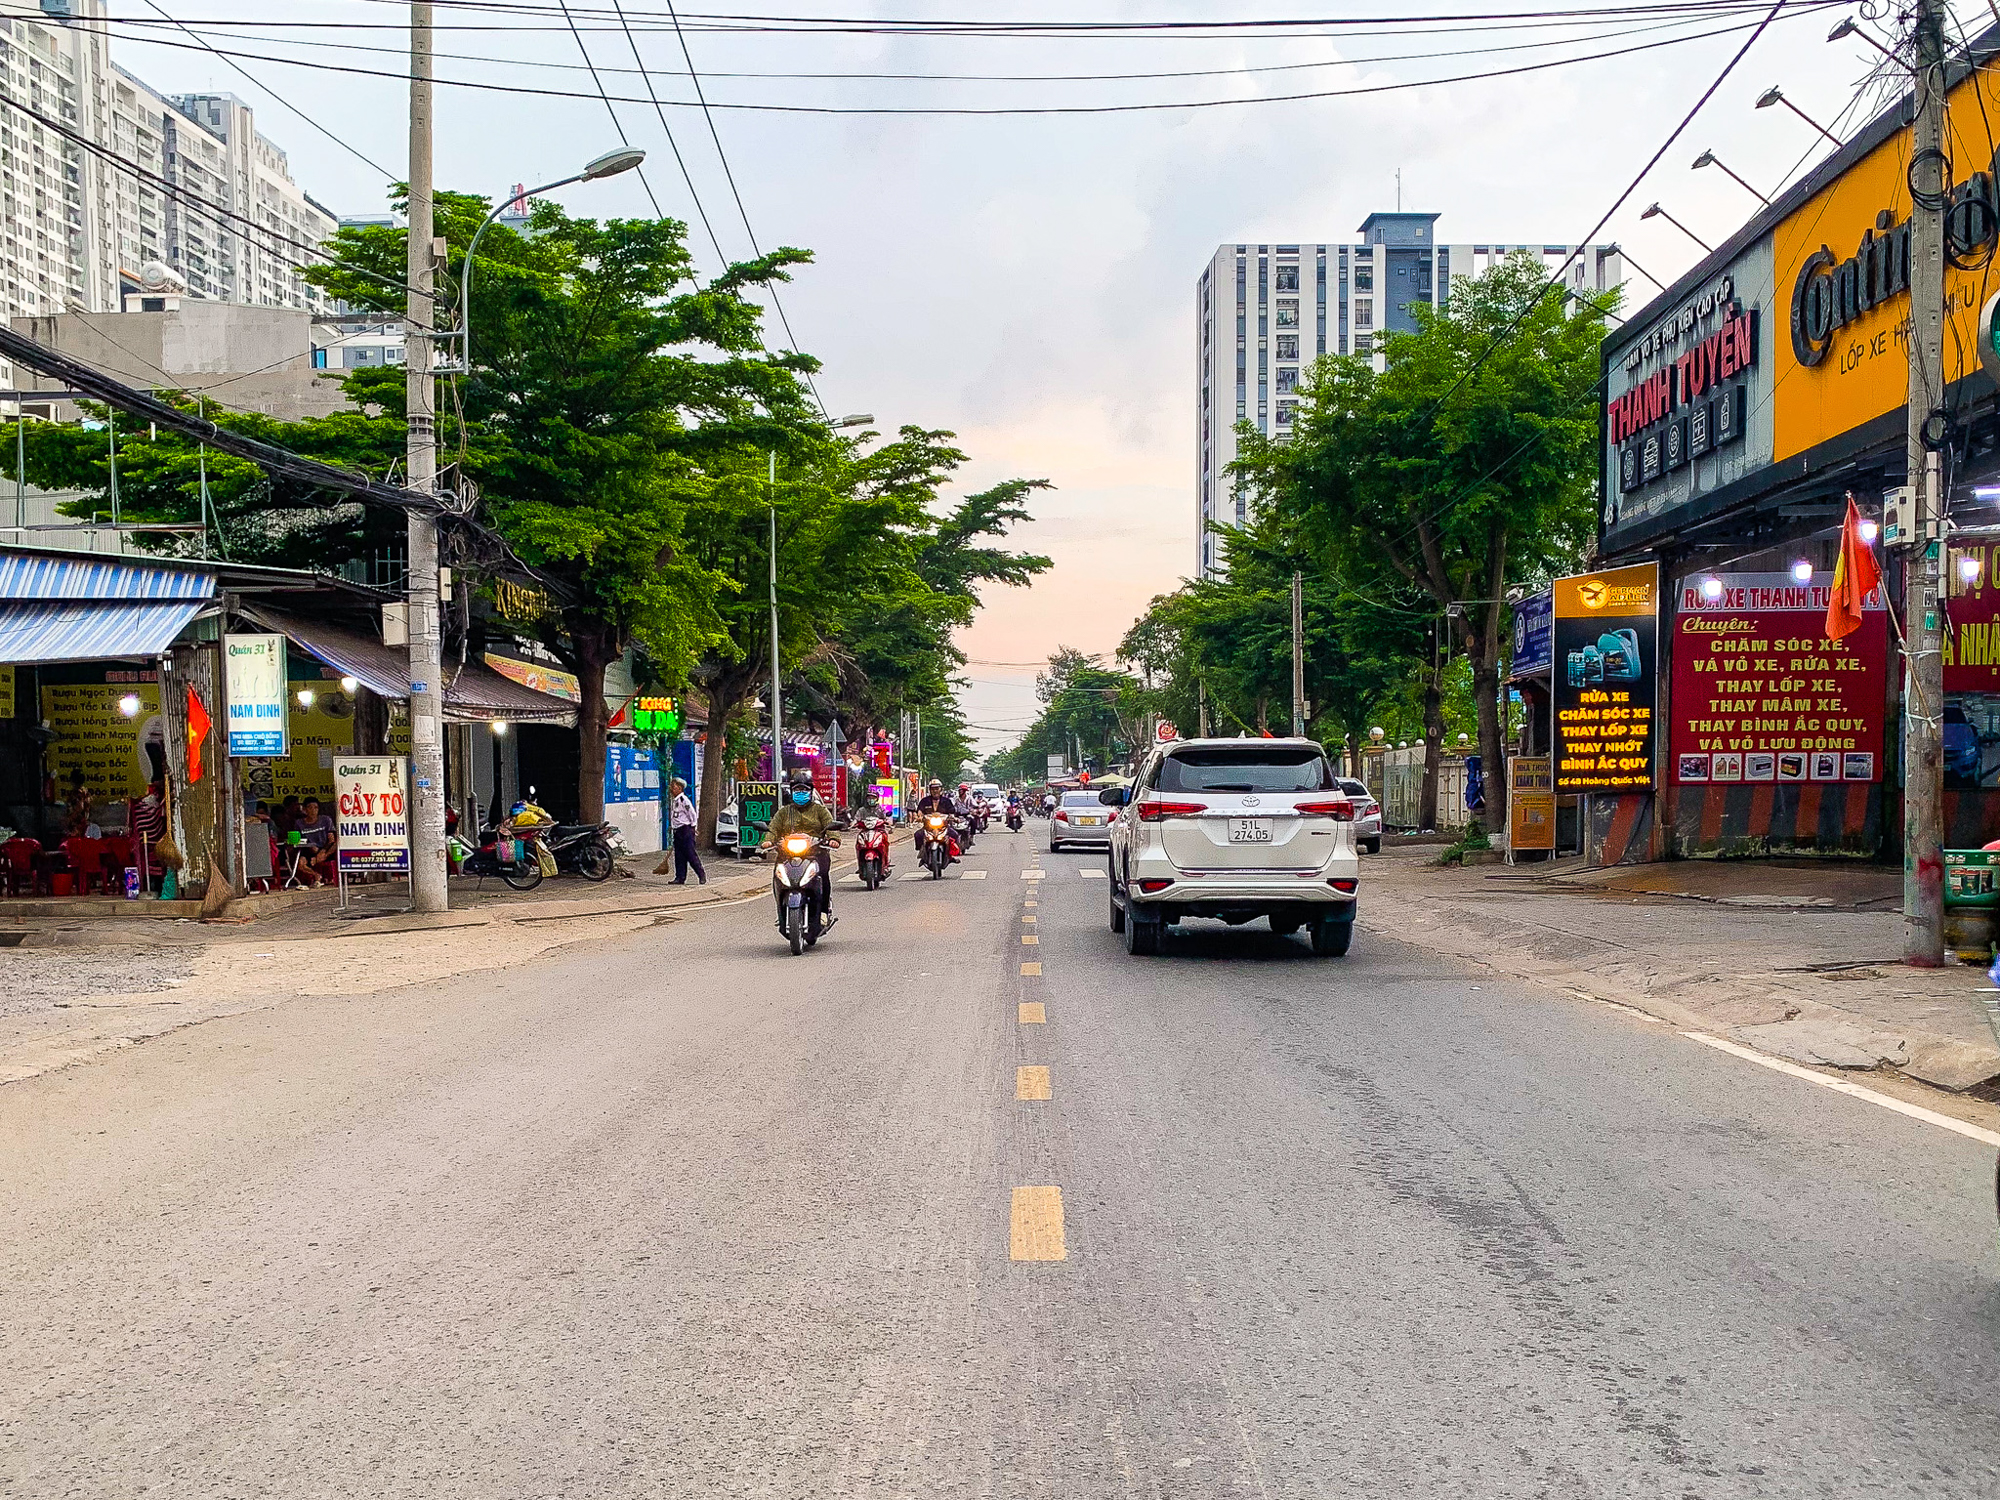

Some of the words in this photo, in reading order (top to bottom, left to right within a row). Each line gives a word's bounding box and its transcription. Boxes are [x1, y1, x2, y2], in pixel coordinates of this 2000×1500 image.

[1652, 333, 1661, 351] XE
[1662, 324, 1677, 343] PHỤ
[1696, 294, 1712, 319] CAO
[1714, 274, 1731, 304] CẤP
[1840, 338, 1865, 375] LỐP
[1869, 330, 1887, 360] XE
[1608, 366, 1671, 445] THANH
[1677, 301, 1751, 404] TUYỀN
[1603, 503, 1614, 526] 48
[1724, 588, 1746, 610] XE
[1750, 587, 1808, 610] THANH
[1682, 616, 1759, 637] Chuyên:
[228, 644, 253, 657] Quán
[253, 644, 265, 655] 31
[1711, 637, 1768, 653] CHĂM
[1773, 636, 1813, 652] SÓC
[1818, 638, 1850, 653] XE,
[1693, 656, 1718, 672] VÁ
[1723, 655, 1748, 672] VỎ
[1754, 659, 1785, 673] XE,
[1790, 655, 1831, 672] RỬA
[1835, 658, 1867, 673] XE,
[1715, 680, 1764, 693] THAY
[1769, 675, 1806, 693] LỐP
[1811, 679, 1843, 693] XE,
[52, 689, 77, 698] Rượu
[79, 689, 105, 698] Ngọc
[1580, 689, 1609, 703] RỬA
[1612, 692, 1630, 702] XE
[53, 703, 78, 713] Rượu
[230, 704, 253, 718] NAM
[641, 697, 672, 710] KING
[1709, 699, 1757, 713] THAY
[1762, 696, 1811, 712] MÂM
[1816, 698, 1849, 713] XE,
[654, 710, 678, 730] DA
[1559, 707, 1600, 720] CHĂM
[1602, 706, 1630, 719] SÓC
[1633, 708, 1651, 719] XE
[55, 717, 79, 727] Rượu
[1561, 725, 1598, 737] THAY
[1600, 722, 1628, 736] LỐP
[1630, 724, 1648, 735] XE
[1688, 720, 1736, 733] THAY
[1741, 717, 1789, 732] BÌNH
[1794, 714, 1820, 732] ẮC
[1825, 718, 1868, 733] QUY,
[83, 732, 106, 740] Minh
[109, 731, 137, 742] Mạng
[1699, 736, 1723, 750] VÁ
[1728, 735, 1754, 750] VỎ
[1759, 737, 1796, 749] LƯU
[1801, 735, 1856, 752] ĐỘNG
[1566, 742, 1603, 753] THAY
[1605, 739, 1643, 752] NHỚT
[1561, 757, 1595, 770] BÌNH
[1597, 755, 1617, 769] ẮC
[1619, 757, 1649, 770] QUY
[339, 764, 367, 777] Quán
[368, 764, 381, 775] 31
[1558, 776, 1569, 785] Số
[1570, 777, 1581, 785] 48
[1582, 776, 1610, 786] Hoàng
[1611, 776, 1633, 785] Quốc
[1633, 775, 1651, 785] Việt
[740, 784, 776, 796] KING
[745, 801, 773, 822] BI
[340, 822, 370, 836] NAM
[374, 822, 406, 839] ĐỊNH
[1241, 820, 1260, 830] 51L
[740, 826, 766, 847] D
[1234, 830, 1268, 840] 274.05
